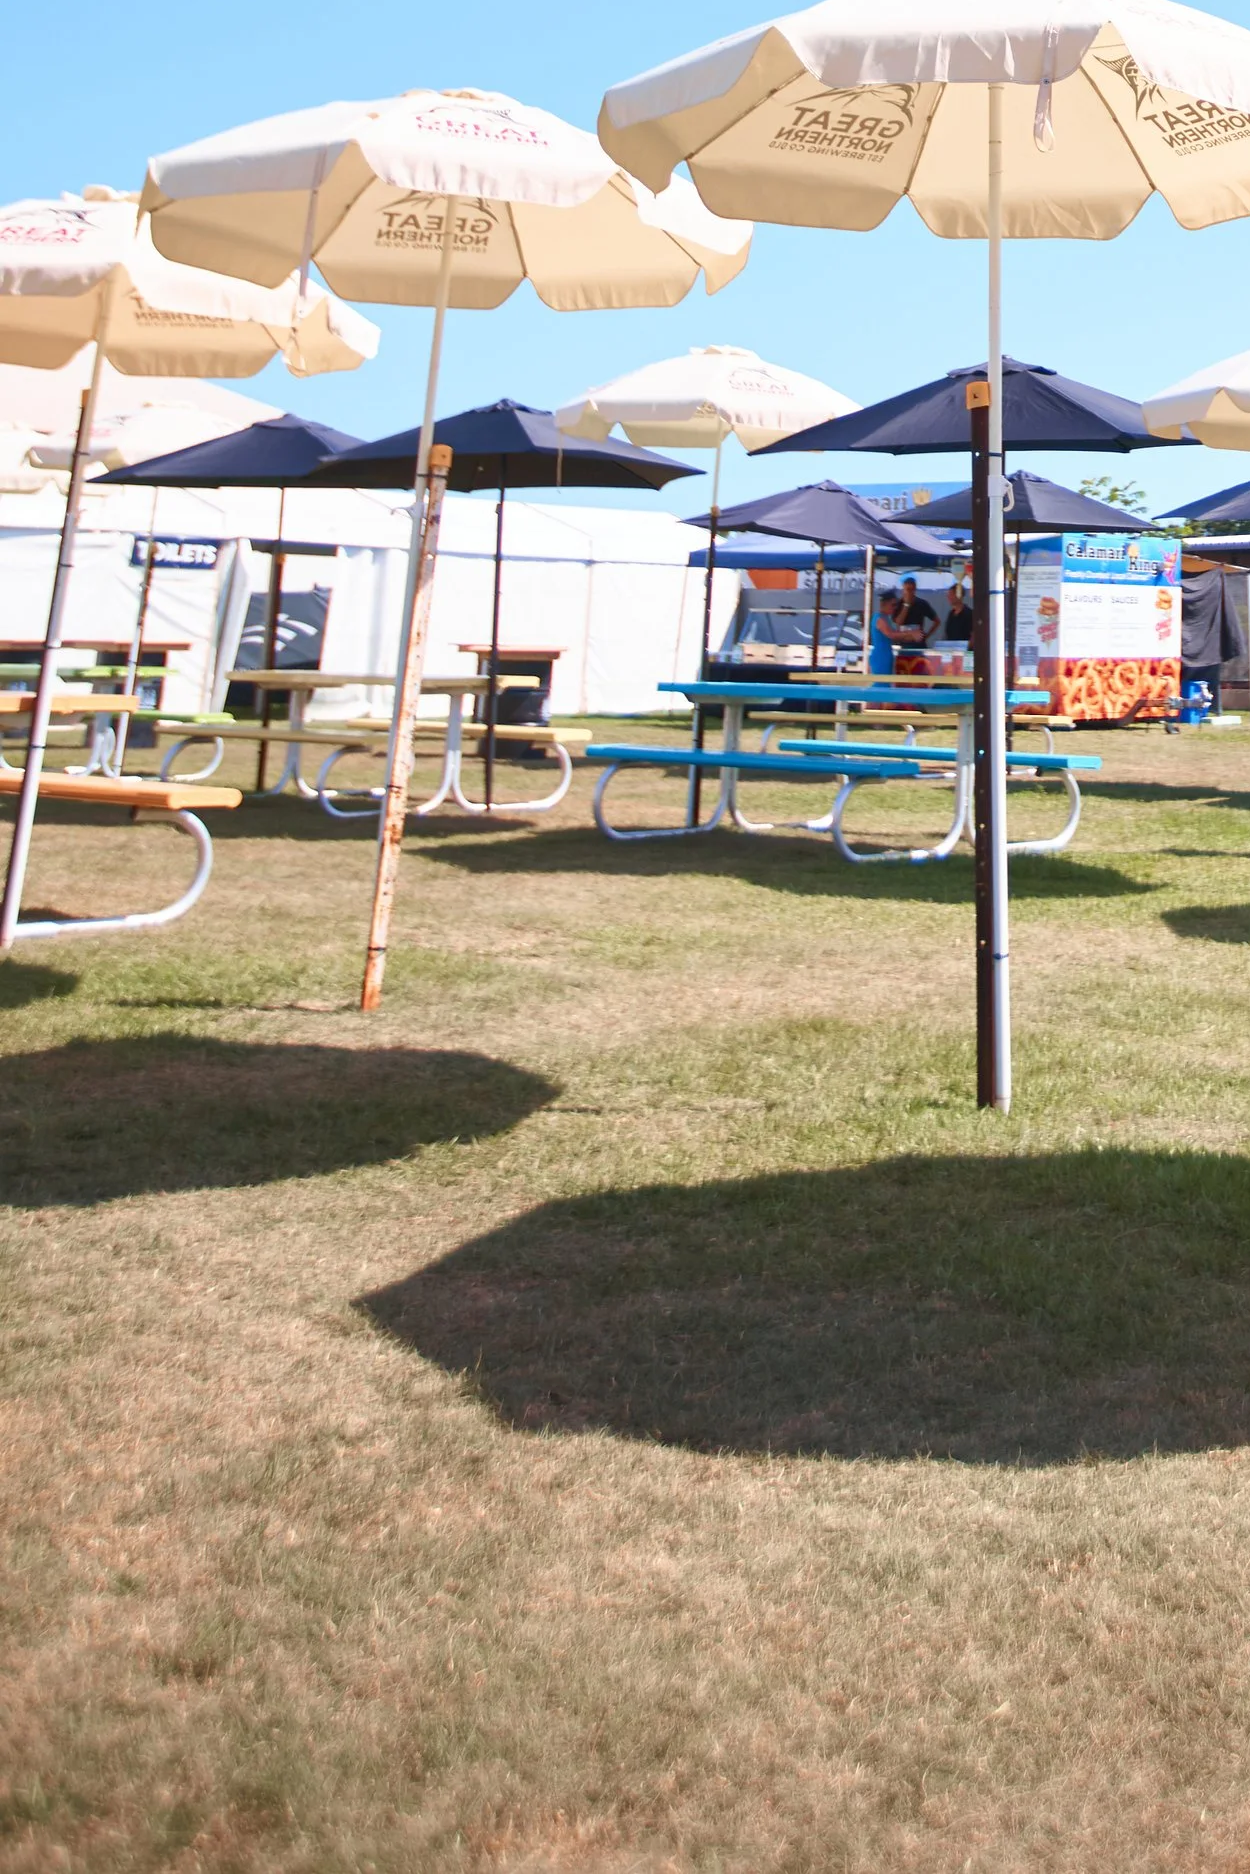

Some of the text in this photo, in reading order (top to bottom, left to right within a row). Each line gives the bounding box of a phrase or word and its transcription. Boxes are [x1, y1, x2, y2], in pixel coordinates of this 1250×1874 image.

[136, 539, 218, 564] TOILETS
[1066, 540, 1126, 560] Calamari
[1128, 556, 1159, 576] King
[1064, 594, 1139, 604] FLAVOURS SAUCES
